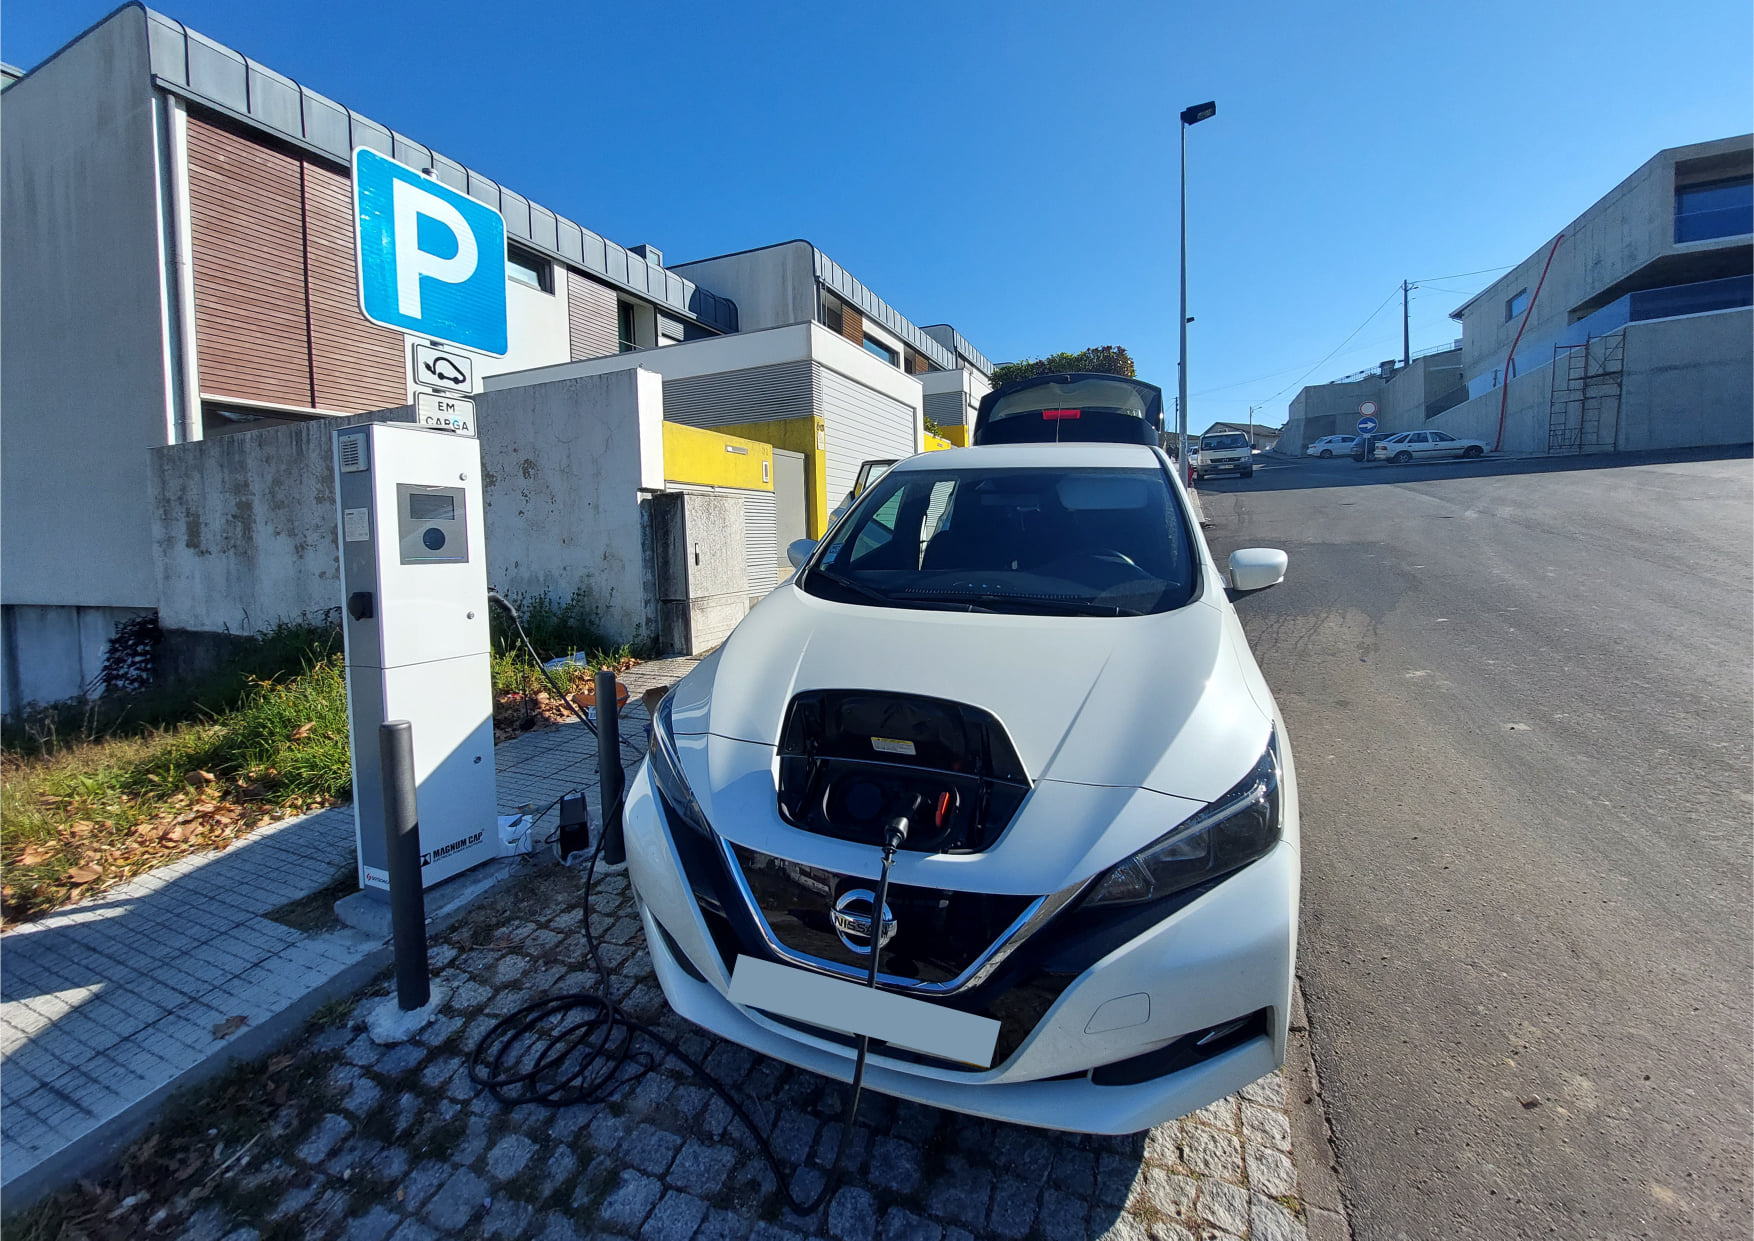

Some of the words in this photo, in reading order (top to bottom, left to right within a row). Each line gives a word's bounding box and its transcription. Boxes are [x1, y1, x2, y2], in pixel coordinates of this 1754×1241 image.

[393, 177, 478, 319] P
[438, 401, 455, 412] EM
[433, 838, 467, 859] MAGNUM
[468, 832, 483, 844] CAP
